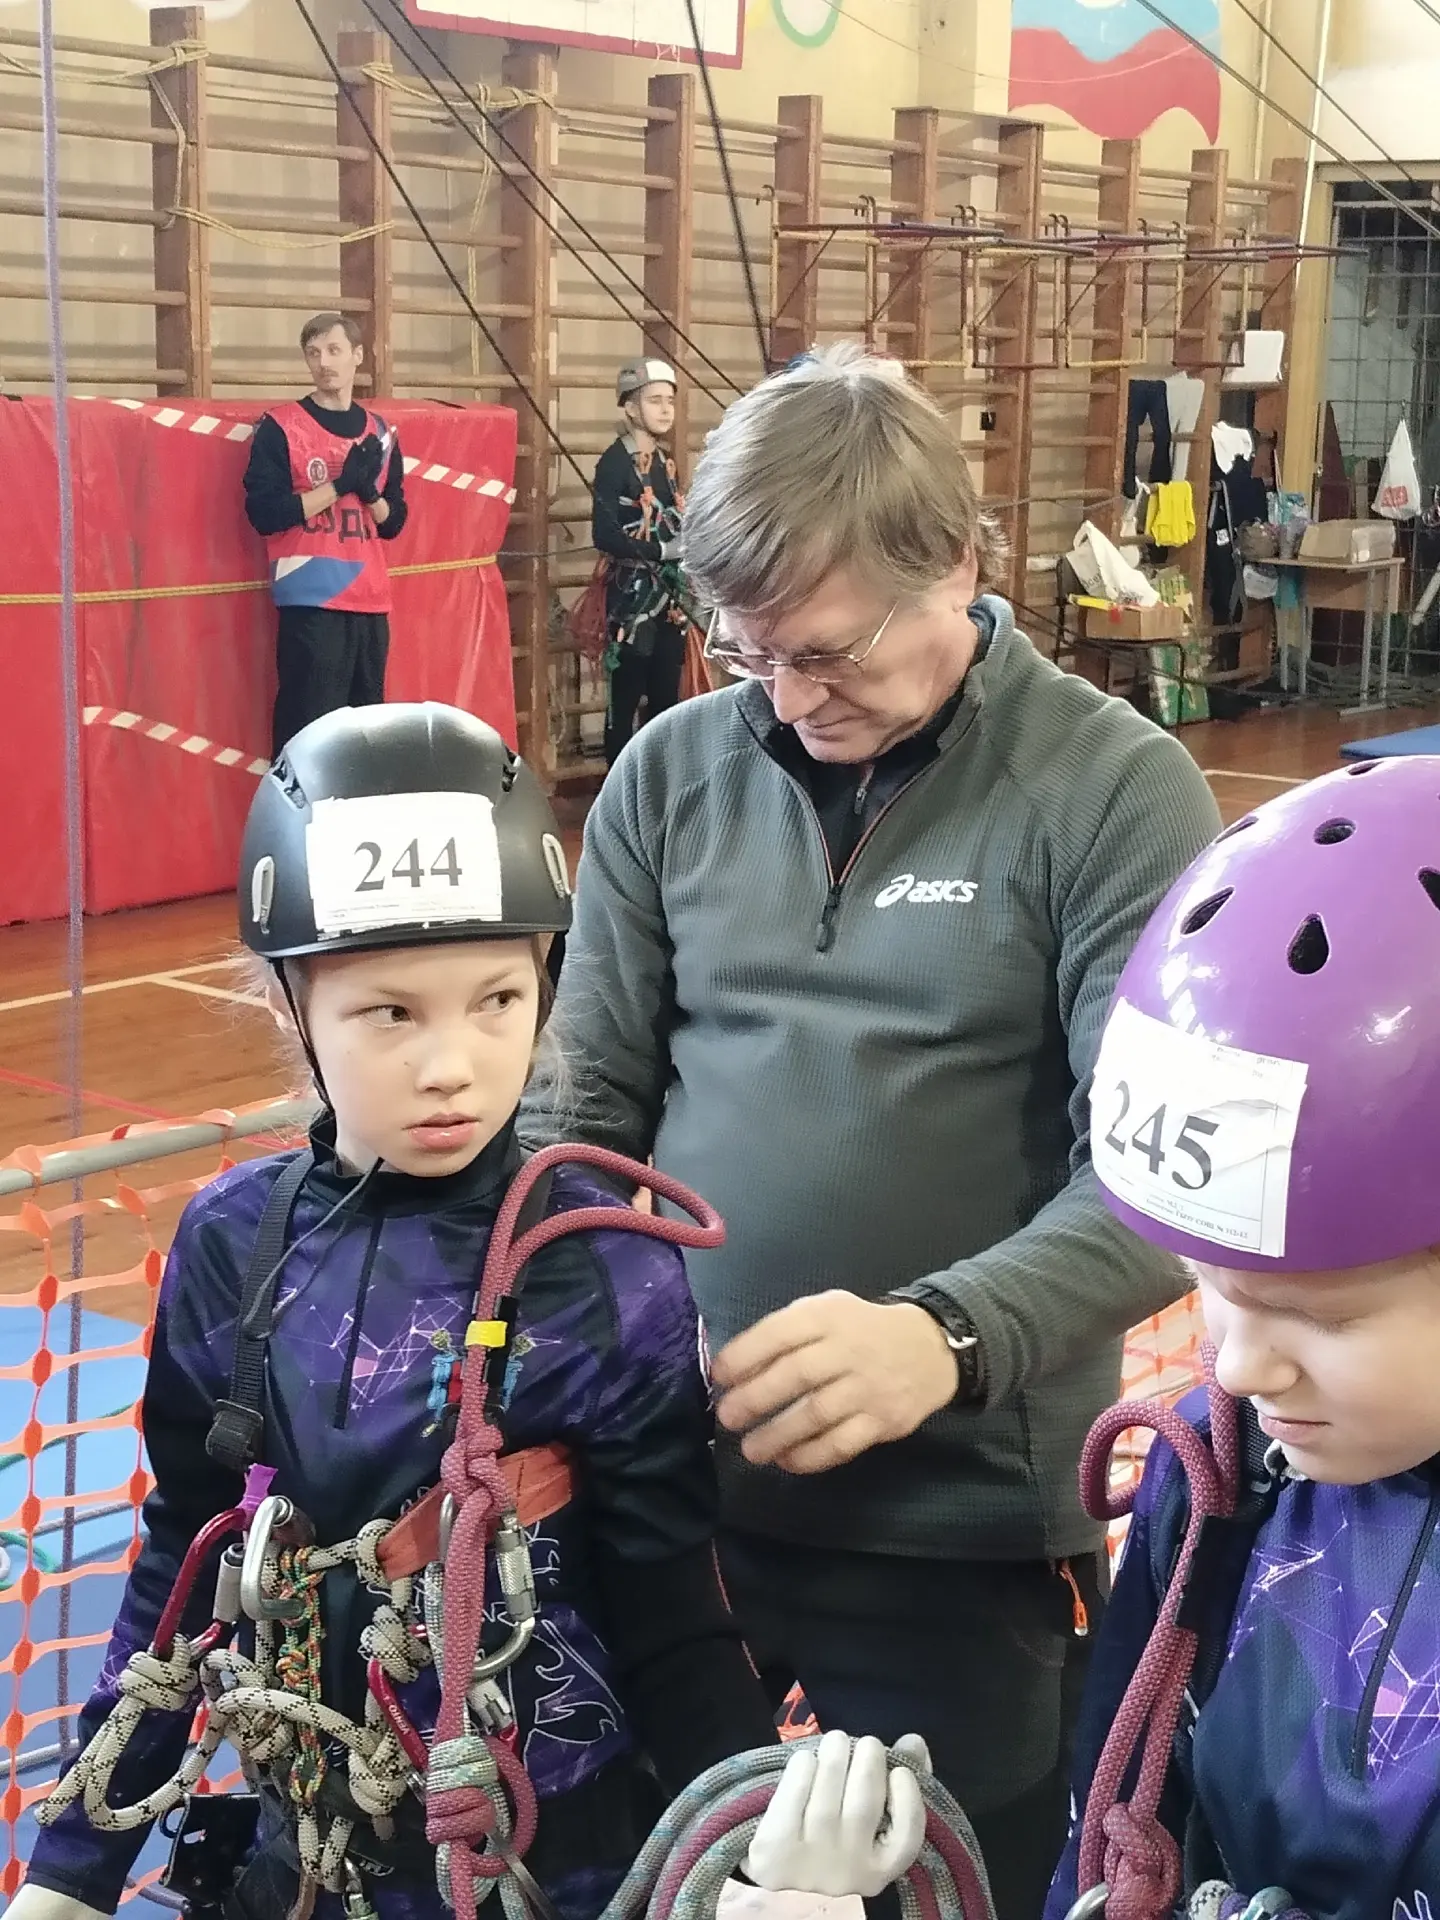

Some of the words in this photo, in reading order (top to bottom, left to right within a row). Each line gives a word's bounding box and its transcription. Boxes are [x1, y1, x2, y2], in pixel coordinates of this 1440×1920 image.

[353, 836, 463, 892] 244
[1103, 1080, 1221, 1191] 245
[388, 1704, 411, 1735] VENTO
